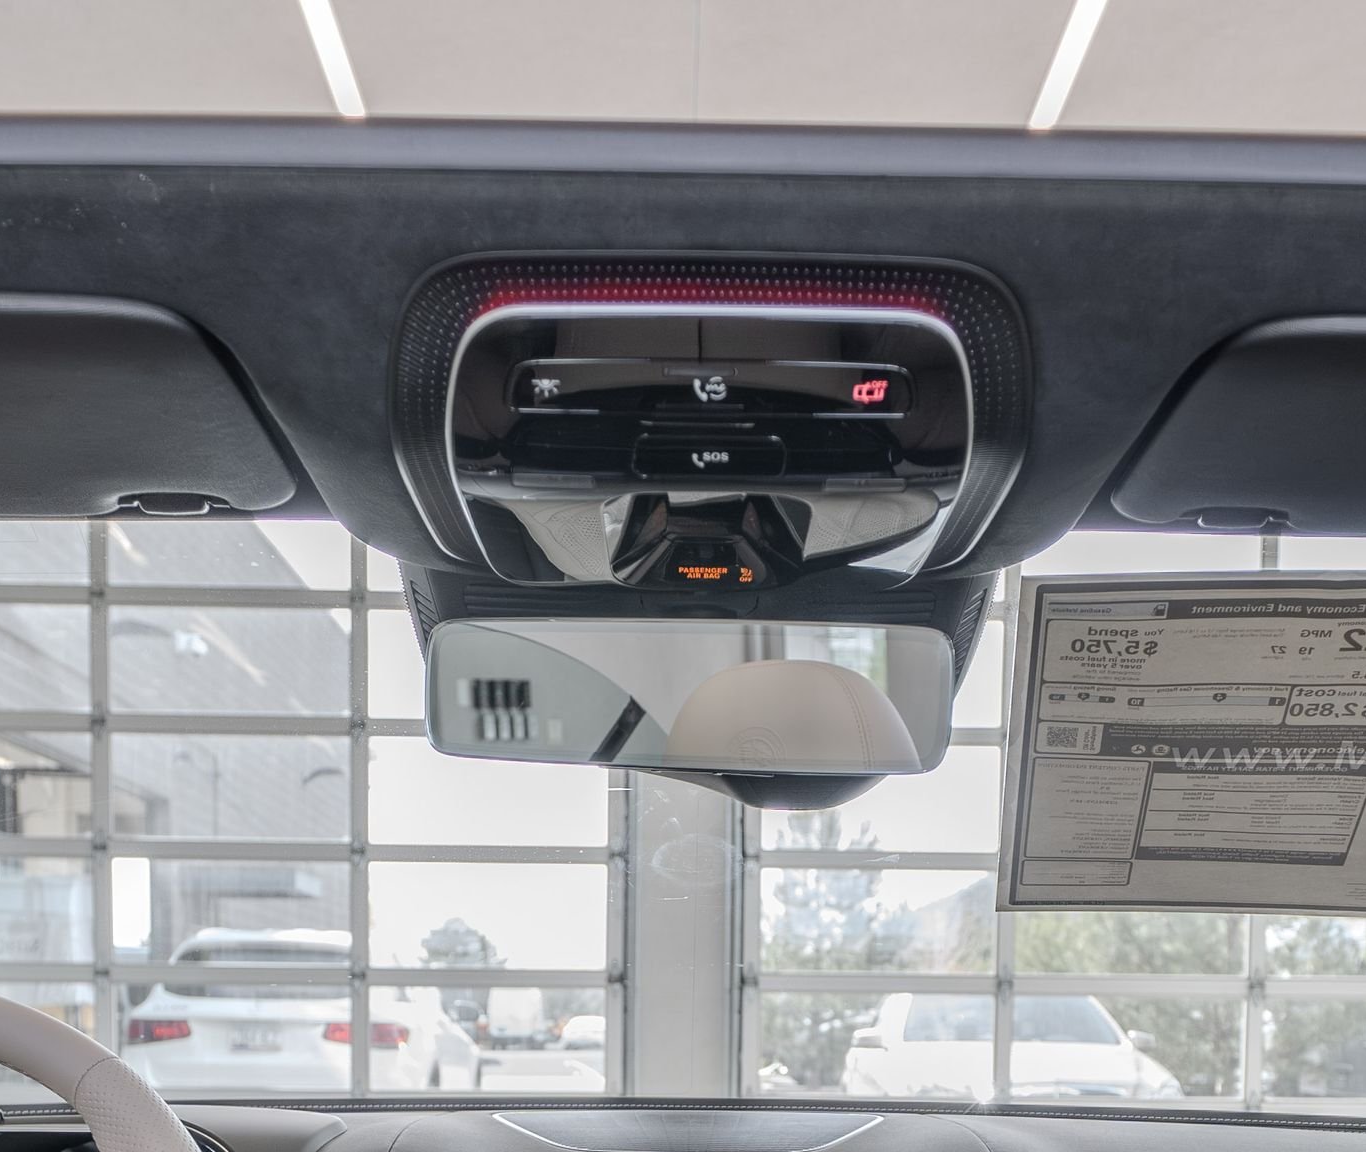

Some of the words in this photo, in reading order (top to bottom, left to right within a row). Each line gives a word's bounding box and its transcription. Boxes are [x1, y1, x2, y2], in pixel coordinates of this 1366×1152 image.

[869, 379, 888, 390] OFF
[702, 451, 730, 463] SOS
[678, 566, 728, 574] PASSENGER
